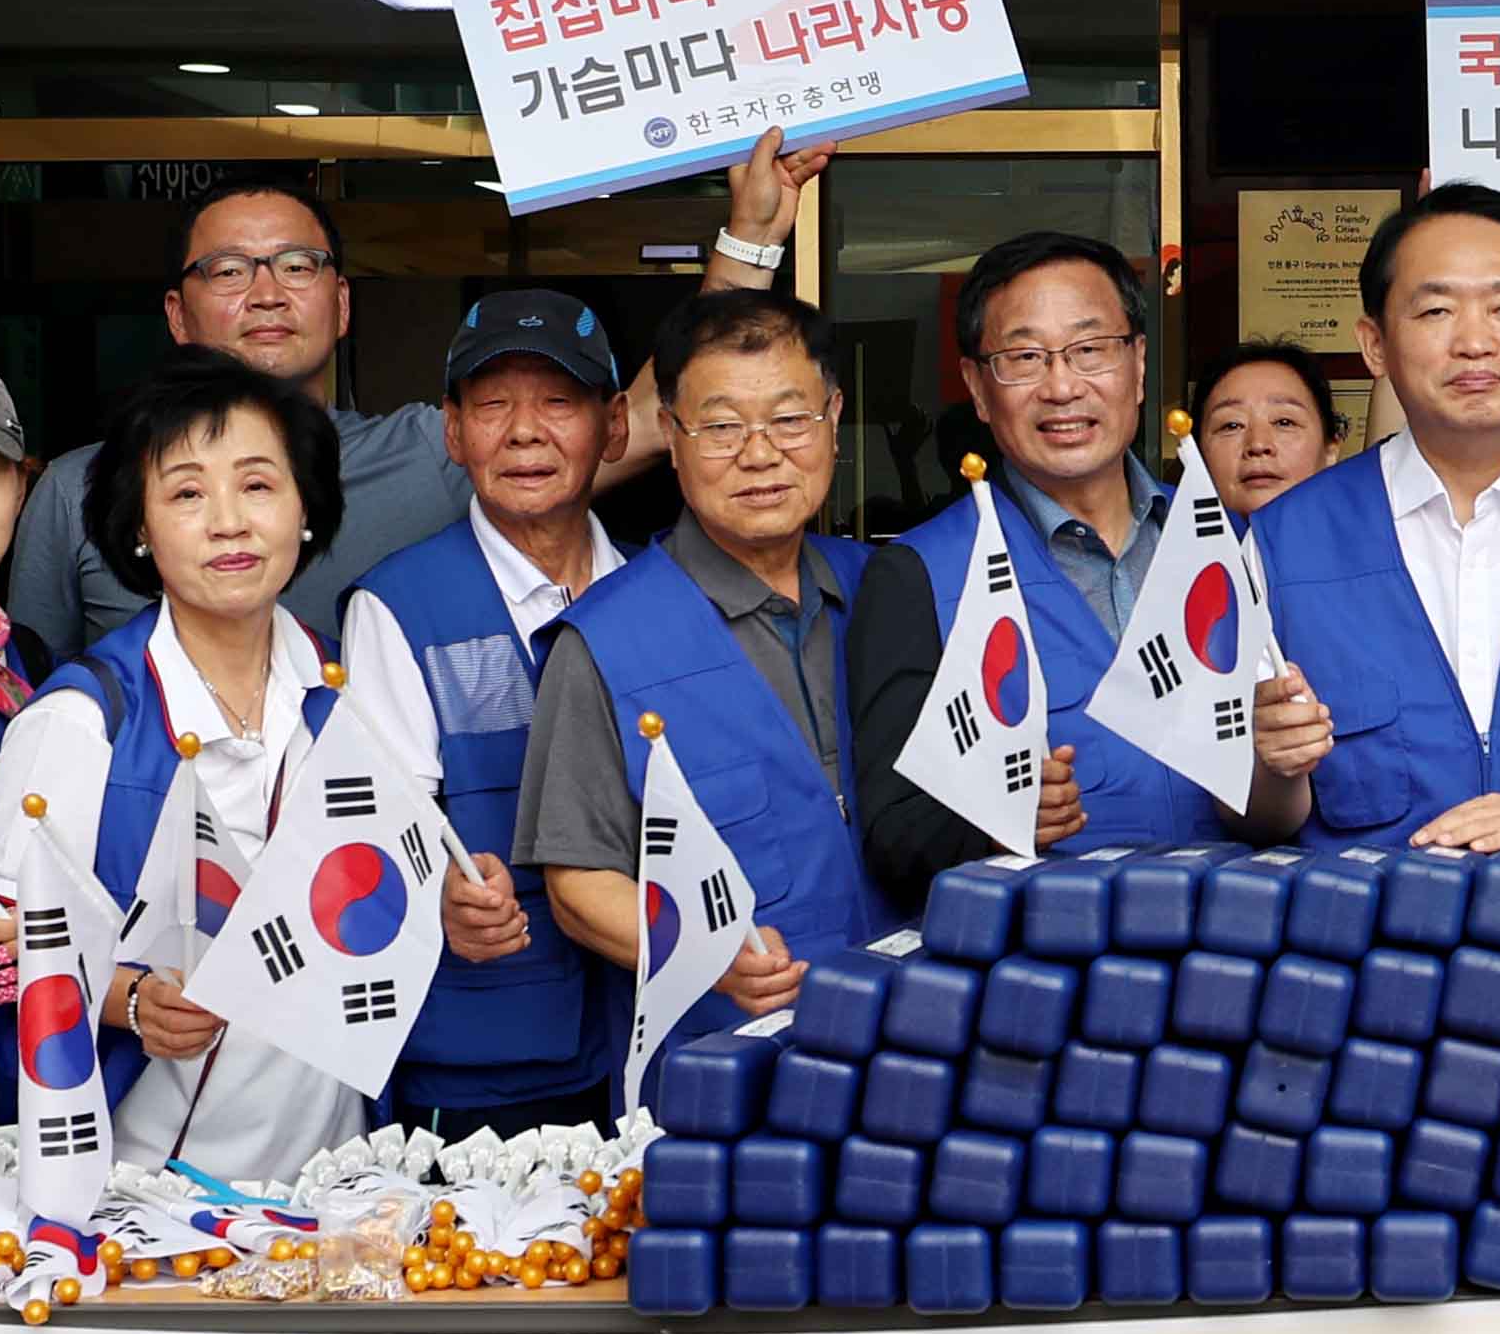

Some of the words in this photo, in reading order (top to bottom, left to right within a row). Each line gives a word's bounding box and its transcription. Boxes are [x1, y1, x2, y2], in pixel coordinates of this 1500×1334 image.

[512, 29, 736, 121] 가슴마다
[685, 70, 883, 135] 한국자유총연맹
[1335, 205, 1358, 214] Child
[1335, 215, 1371, 225] Friendly
[1335, 225, 1360, 234] Cities
[1335, 235, 1373, 244] Initiativ
[1300, 319, 1328, 329] unicef
